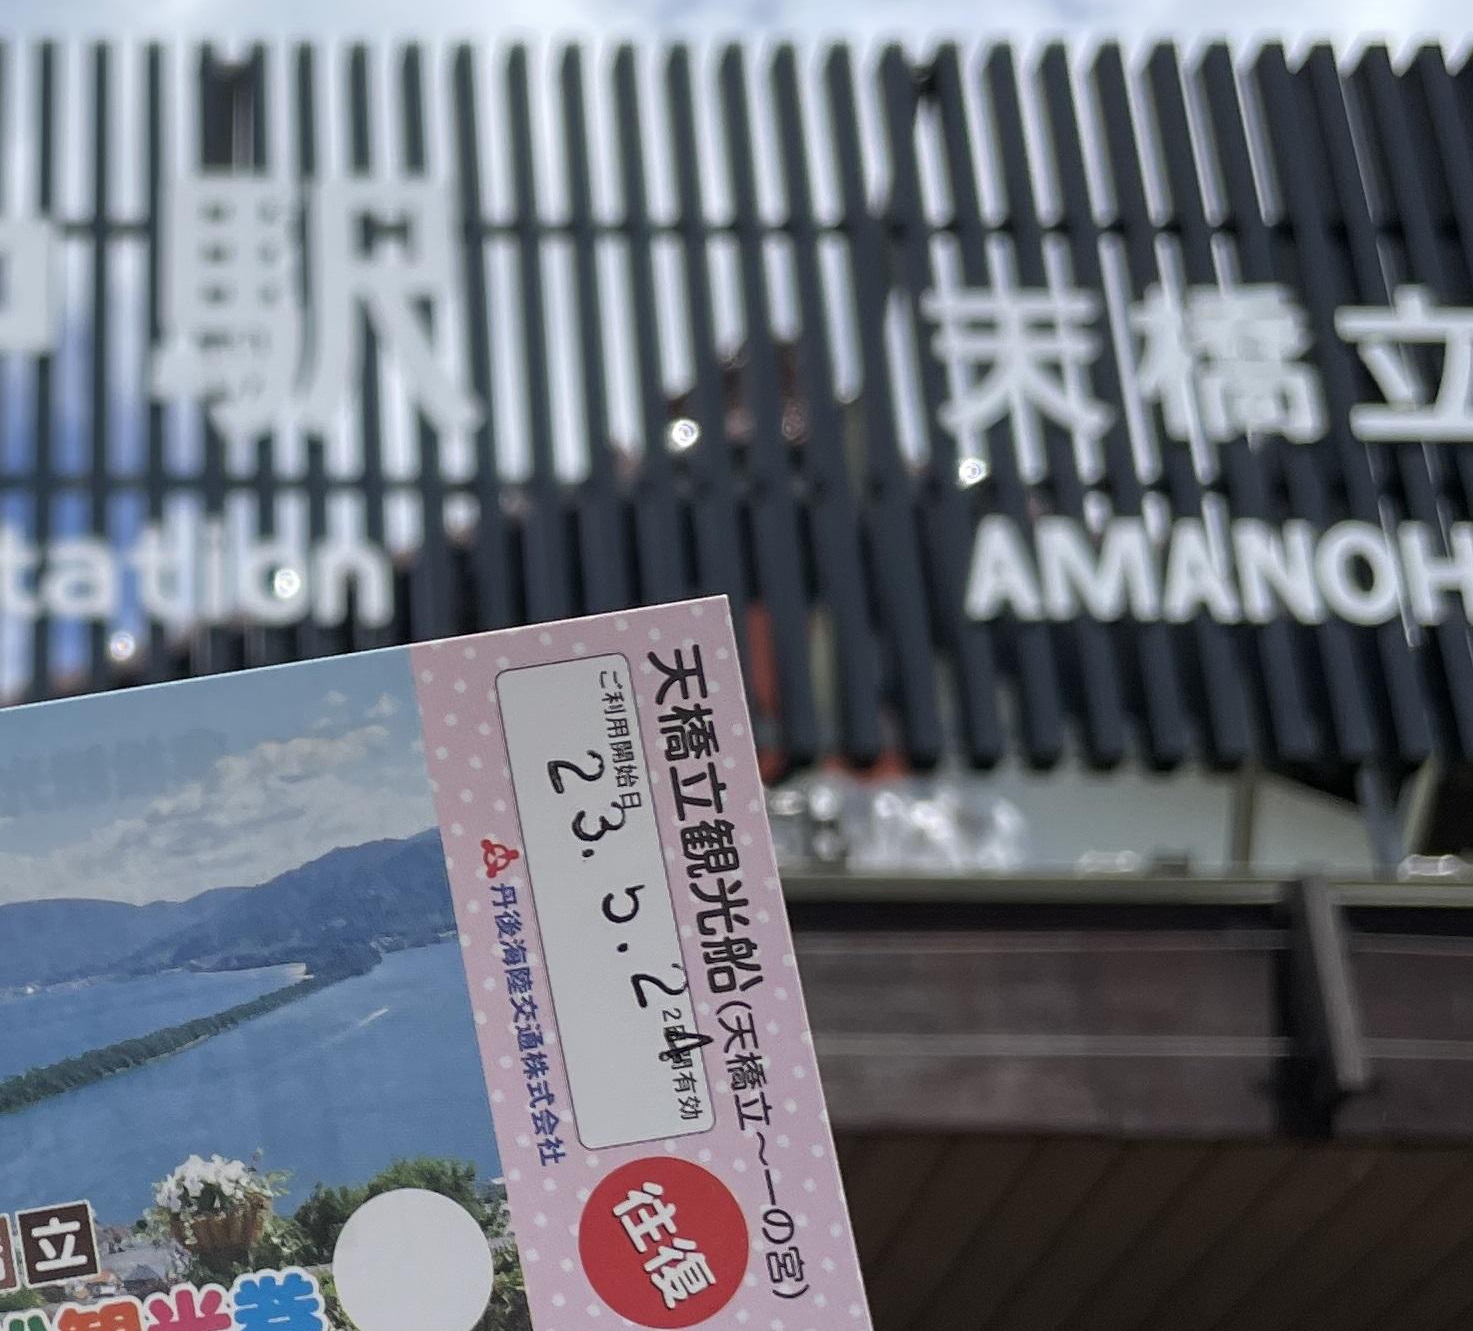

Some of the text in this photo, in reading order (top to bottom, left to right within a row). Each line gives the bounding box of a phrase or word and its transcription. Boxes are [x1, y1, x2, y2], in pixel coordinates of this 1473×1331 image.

[920, 280, 1473, 444] 天橋立
[599, 670, 642, 810] ご利用開始日
[489, 882, 566, 1167] 丹後海陸交通株式会社
[611, 1180, 718, 1310] 往復
